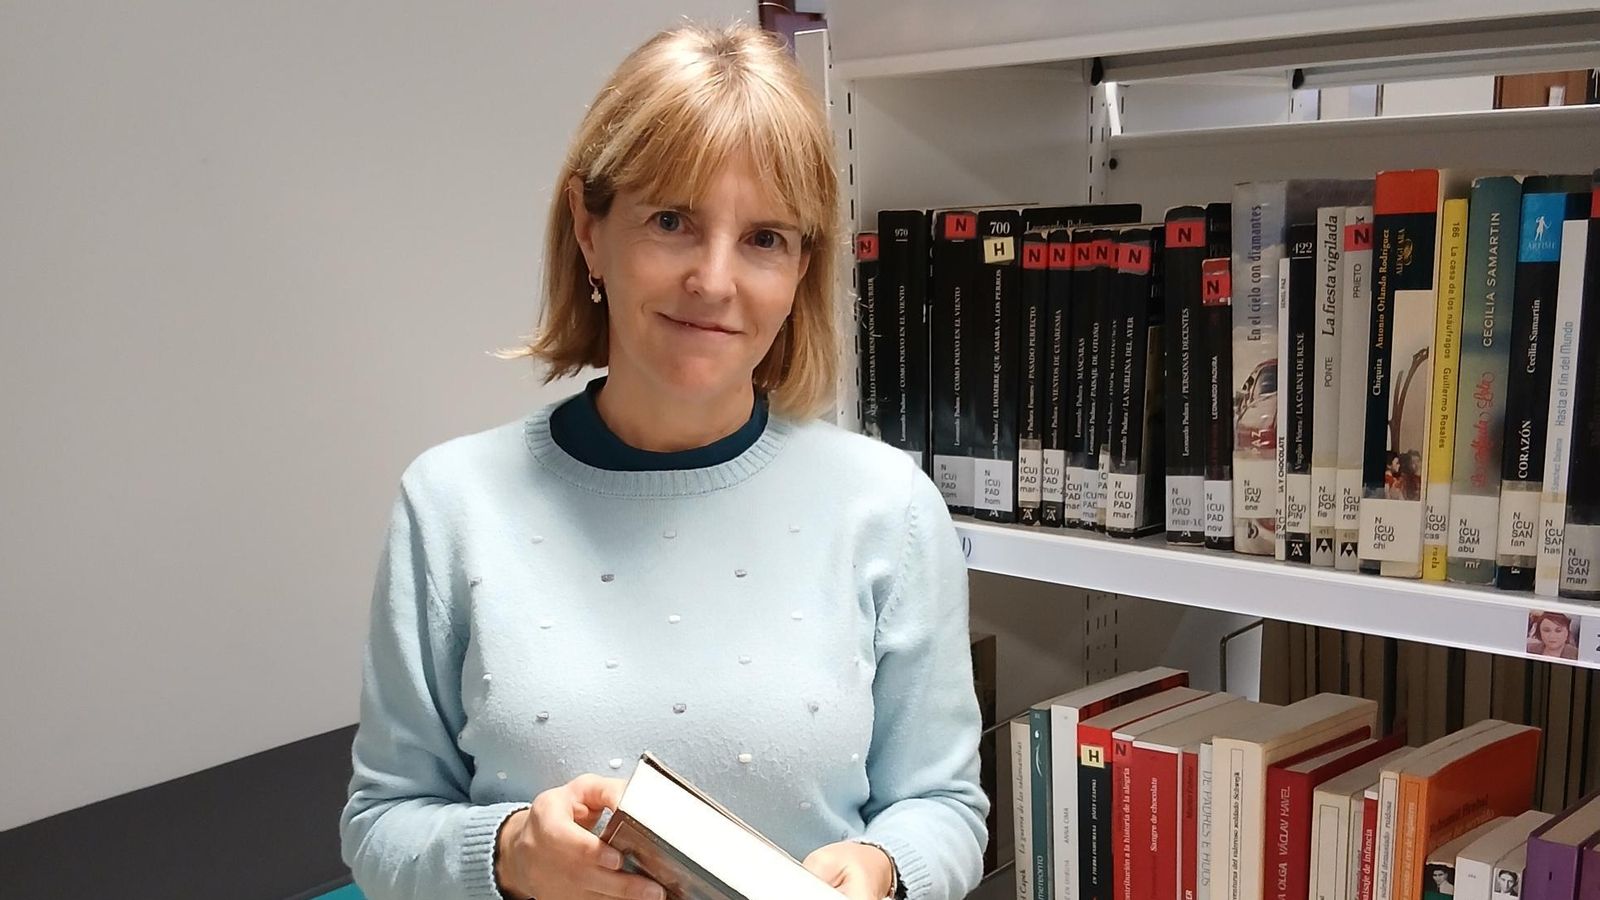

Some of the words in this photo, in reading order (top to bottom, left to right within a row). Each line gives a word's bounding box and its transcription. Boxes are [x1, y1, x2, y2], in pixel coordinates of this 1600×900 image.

[956, 218, 967, 232] N
[989, 221, 1011, 235] 700
[894, 228, 909, 237] 970
[1178, 227, 1192, 243] N
[1247, 204, 1262, 262] diamantes
[1354, 228, 1369, 245] N
[859, 240, 872, 254] N
[993, 241, 1006, 257] H
[1292, 242, 1313, 254] 422
[1323, 215, 1340, 272] vigilada
[1486, 212, 1501, 287] SAMARTIN
[1028, 248, 1041, 262] N
[1053, 248, 1066, 262] N
[1077, 247, 1090, 261] N
[1096, 246, 1108, 260] N
[1128, 248, 1142, 264] N
[1450, 246, 1459, 257] La
[1250, 265, 1262, 284] con
[1448, 259, 1457, 281] casa
[1206, 280, 1220, 295] N
[1352, 263, 1363, 299] PRIETO
[1322, 274, 1336, 315] fiesta
[1377, 275, 1388, 312] Orlando
[1447, 283, 1457, 295] de
[1247, 287, 1261, 312] cielo
[1446, 297, 1456, 311] los
[1247, 316, 1261, 326] el
[1483, 291, 1497, 347] CECILIA
[1126, 316, 1134, 339] AYER
[1180, 307, 1190, 351] DECENTES
[1321, 319, 1336, 336] La
[1375, 314, 1386, 349] Antonio
[1246, 329, 1262, 341] En
[1560, 321, 1573, 354] Mundo
[1125, 340, 1133, 357] DEL
[1295, 357, 1304, 370] DE
[1526, 342, 1538, 374] Cecilia
[1559, 355, 1570, 371] del
[1122, 358, 1132, 395] NEBLINA
[1181, 351, 1190, 393] PERSONAS
[1324, 356, 1334, 388] PONTE
[1372, 358, 1384, 396] Chiquita
[1557, 372, 1569, 386] fin
[1295, 371, 1304, 401] CARNE
[1441, 366, 1452, 412] Guillermo
[1557, 388, 1568, 398] el
[1122, 396, 1130, 407] LA
[1295, 402, 1304, 414] LA
[1181, 402, 1190, 425] Padura
[1555, 399, 1567, 427] Hasta
[1121, 412, 1129, 435] Padura
[1438, 414, 1449, 449] Rosales
[1119, 436, 1128, 467] Leonardo
[1517, 420, 1531, 479] CORAZÓN
[1278, 436, 1286, 478] CHOCOLATE
[941, 472, 957, 482] (CU)
[1020, 466, 1038, 476] (CU)
[941, 482, 957, 490] PAD
[985, 479, 1001, 488] (CU)
[1020, 476, 1037, 484] PAD
[1244, 479, 1250, 487] N
[984, 488, 1000, 497] PAD
[1114, 490, 1134, 501] (CU)
[1172, 487, 1179, 496] N
[1244, 487, 1262, 497] (CU)
[1319, 485, 1326, 493] N
[1343, 487, 1351, 495] N
[1172, 497, 1192, 507] (CU)
[1206, 492, 1213, 501] N
[1244, 494, 1261, 503] PAZ
[1288, 495, 1295, 503] N
[1113, 500, 1132, 510] PAD
[1172, 507, 1190, 516] PAD
[1206, 503, 1225, 513] (CU)
[1287, 503, 1307, 513] (CU)
[1207, 512, 1224, 522] PAD
[1287, 511, 1303, 520] PIN
[1374, 516, 1382, 525] N
[1426, 513, 1447, 524] (CU)
[1512, 511, 1521, 520] N
[1206, 524, 1223, 532] nov
[1425, 522, 1447, 532] ROS
[1459, 518, 1468, 527] N
[1512, 520, 1535, 532] (CU)
[1545, 519, 1554, 528] N
[1374, 524, 1395, 535] (CU)
[1458, 526, 1481, 538] (CU)
[1511, 529, 1533, 540] SAN
[1373, 533, 1396, 543] ROD
[1458, 535, 1481, 546] SAM
[1510, 538, 1526, 548] fan
[1373, 542, 1386, 550] chi
[1457, 545, 1475, 555] abu
[1543, 545, 1561, 555] has
[1568, 547, 1577, 557] N
[1567, 556, 1591, 569] (CU)
[1566, 565, 1591, 577] SAN
[1088, 749, 1100, 763] H
[1115, 743, 1127, 757] N
[1122, 767, 1132, 794] alegría
[1122, 795, 1131, 803] la
[1149, 777, 1158, 814] chocolate
[1279, 786, 1291, 818] HAVEL
[1122, 803, 1131, 813] de
[1149, 814, 1158, 824] de
[1122, 814, 1131, 842] historia
[1149, 824, 1159, 852] Sangre
[1276, 819, 1290, 857] VÁCLAV
[1122, 843, 1131, 851] la
[1362, 828, 1374, 863] infancia
[1362, 863, 1372, 875] de
[1277, 862, 1288, 891] OLGA
